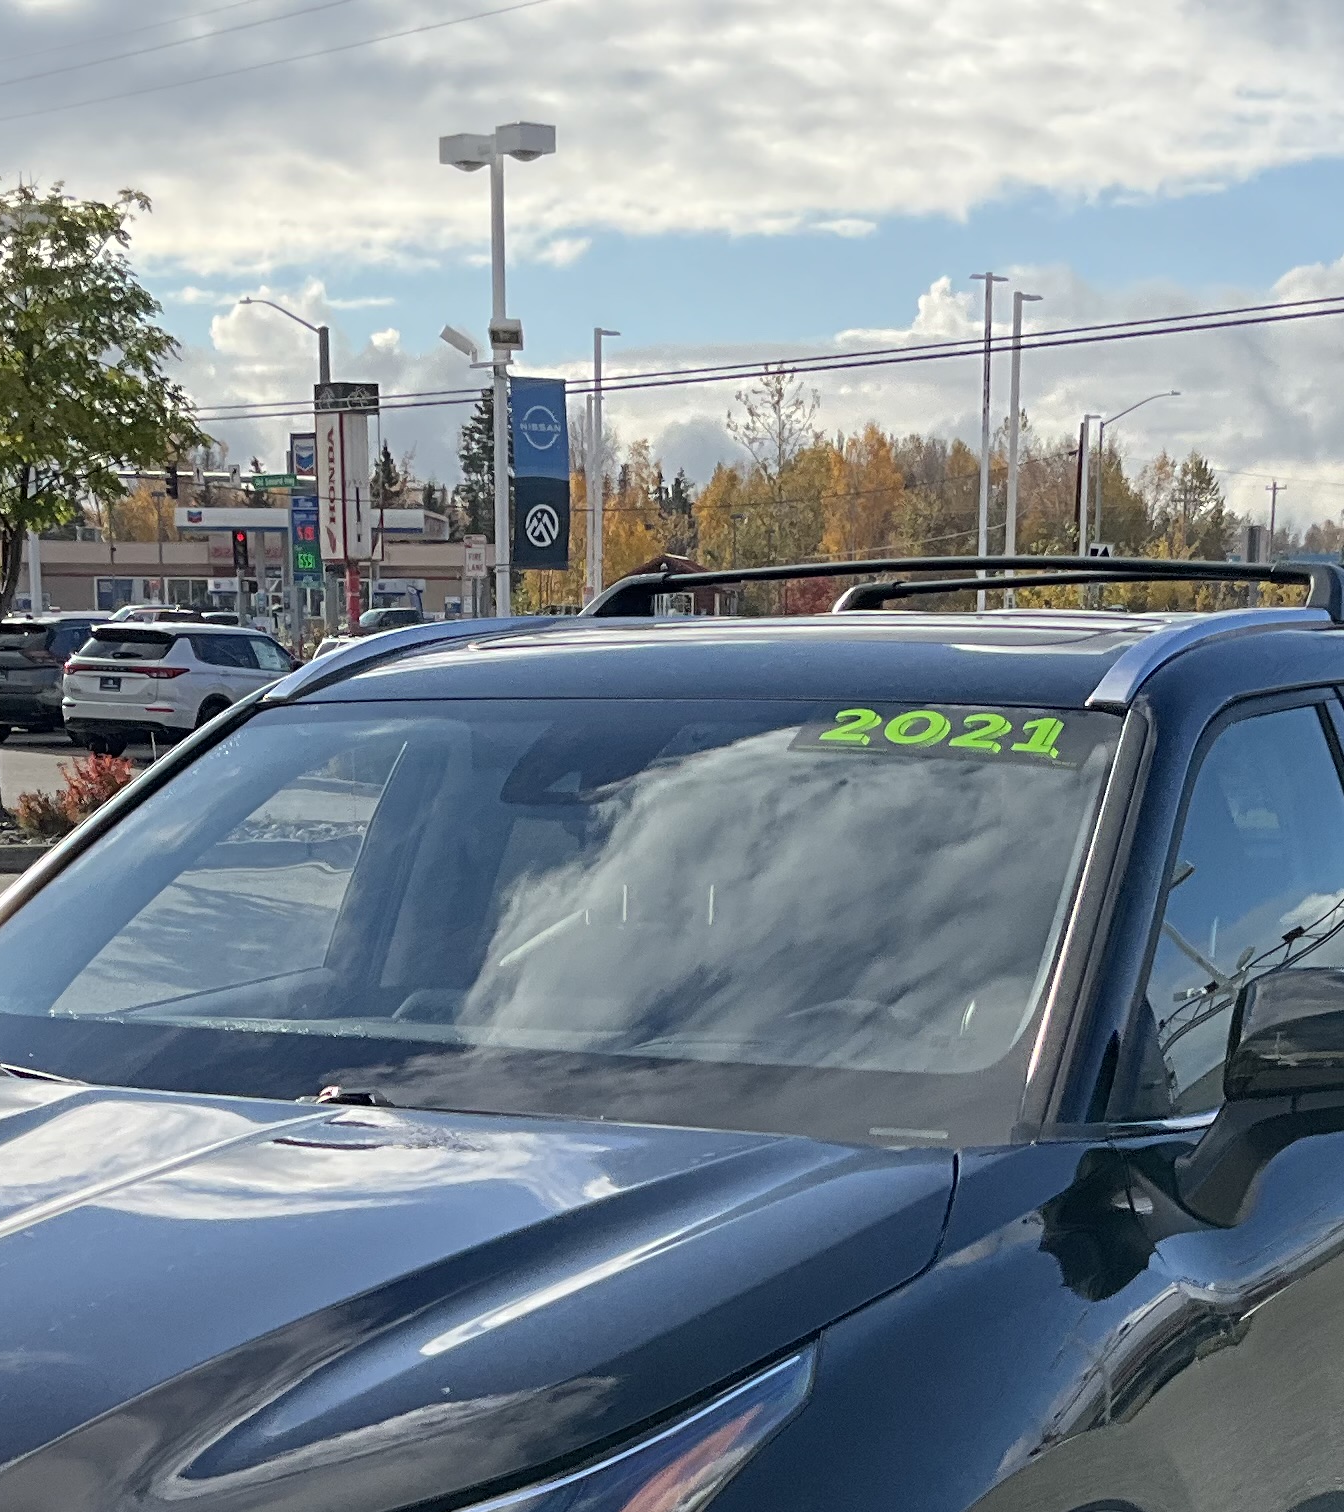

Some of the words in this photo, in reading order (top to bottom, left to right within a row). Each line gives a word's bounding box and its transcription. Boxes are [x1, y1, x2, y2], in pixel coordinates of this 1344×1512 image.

[519, 422, 562, 433] NISSAN
[327, 425, 337, 525] HONDA
[819, 708, 1065, 759] 2021
